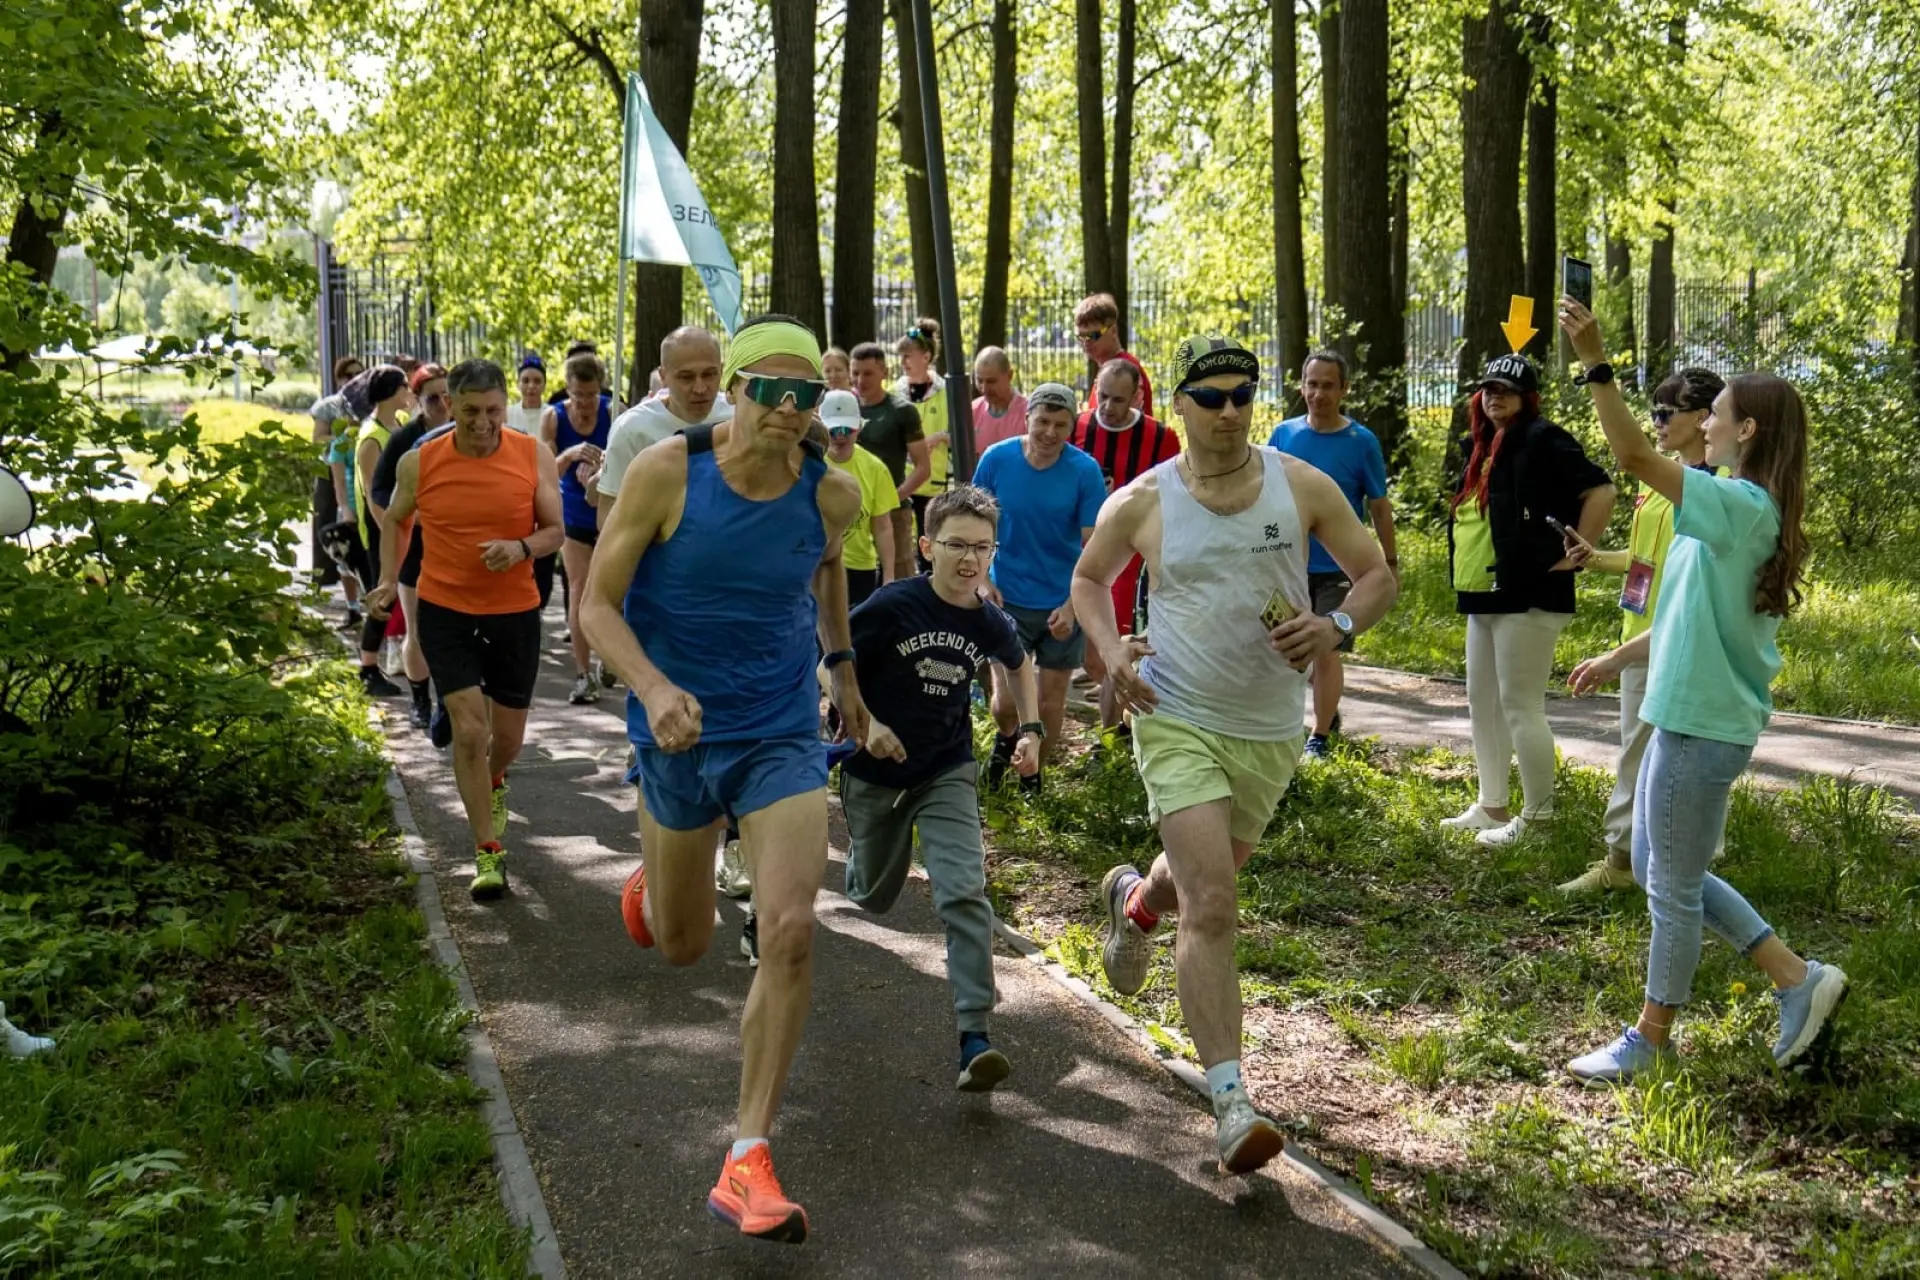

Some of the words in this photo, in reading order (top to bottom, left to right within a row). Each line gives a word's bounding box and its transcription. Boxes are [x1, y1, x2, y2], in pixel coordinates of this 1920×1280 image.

[1486, 358, 1524, 379] ICON
[1251, 546, 1268, 554] run
[896, 631, 965, 657] WEEKEND
[964, 641, 985, 672] CLU
[922, 682, 949, 697] 1976
